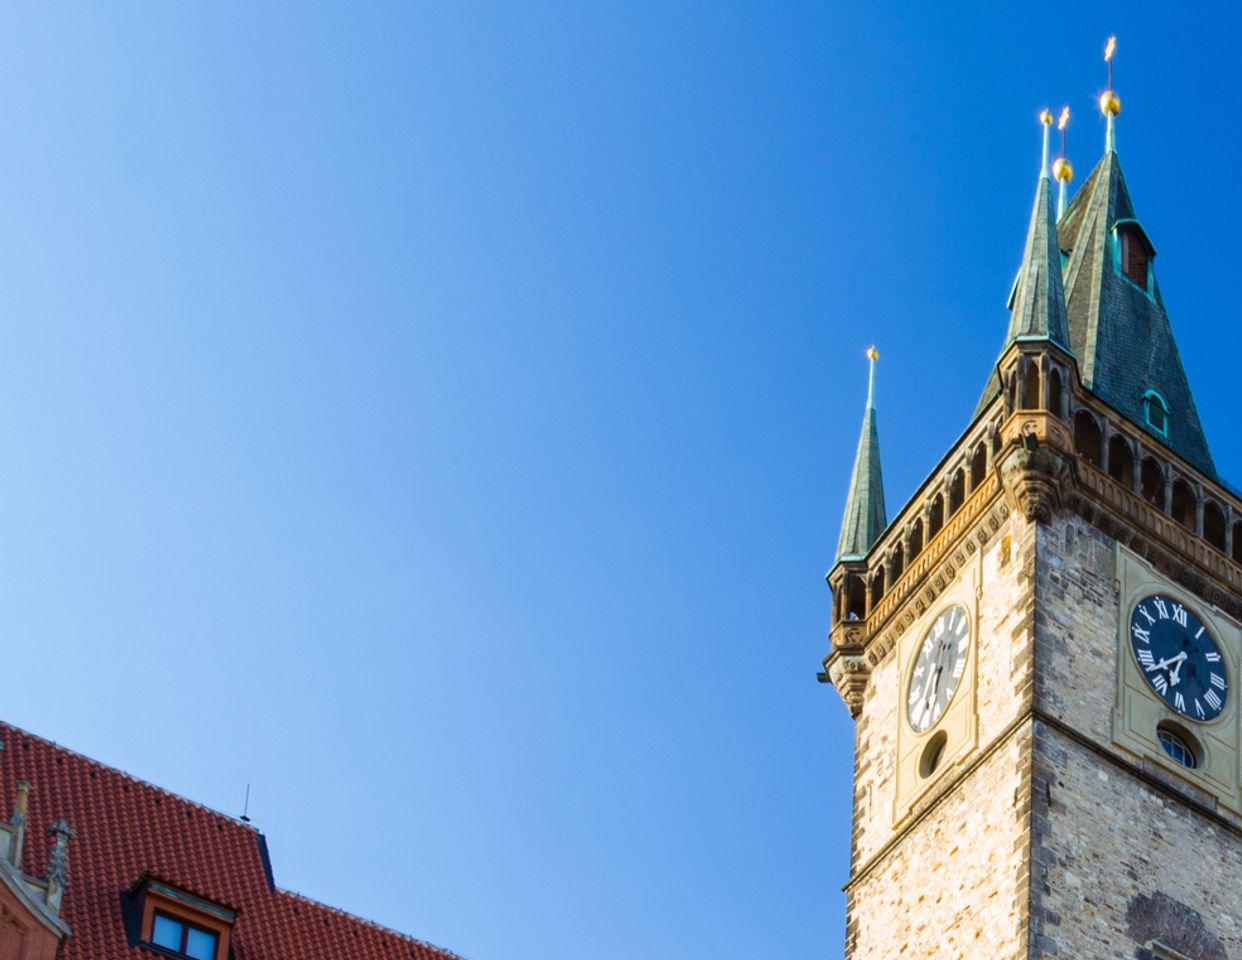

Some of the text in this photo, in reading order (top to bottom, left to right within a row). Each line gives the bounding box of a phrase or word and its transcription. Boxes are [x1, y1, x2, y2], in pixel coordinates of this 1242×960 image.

[1139, 606, 1156, 626] X
[1153, 600, 1170, 620] XI
[1172, 604, 1188, 628] XII
[1134, 623, 1151, 644] IX
[1195, 626, 1205, 640] I
[1137, 649, 1156, 672] VIII
[1205, 651, 1220, 662] II
[1152, 674, 1168, 696] VII
[1210, 672, 1225, 690] III
[1174, 692, 1187, 712] VI
[1194, 698, 1206, 716] V
[1203, 687, 1222, 711] IIII
